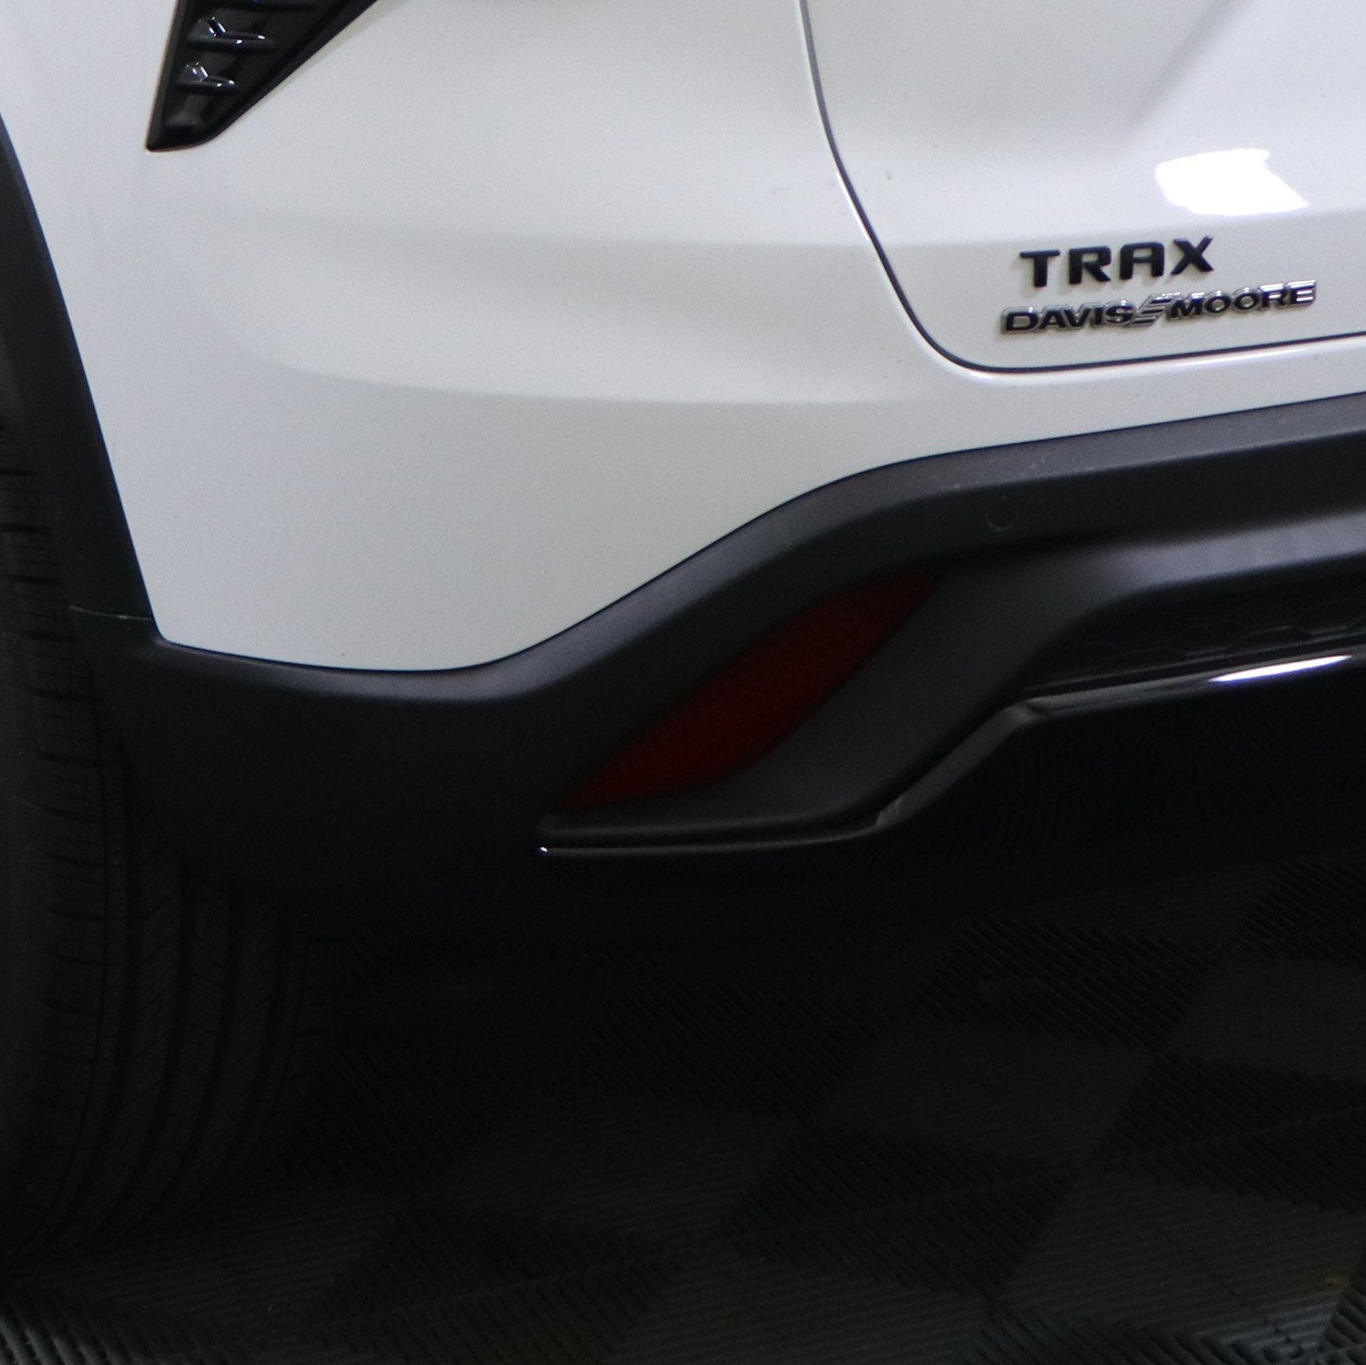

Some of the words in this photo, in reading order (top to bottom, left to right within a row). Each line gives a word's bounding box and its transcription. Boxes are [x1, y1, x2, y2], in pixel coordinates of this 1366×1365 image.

[1019, 236, 1214, 287] TRAX
[1000, 298, 1136, 335] DAVIS
[1166, 279, 1317, 321] MOORE
